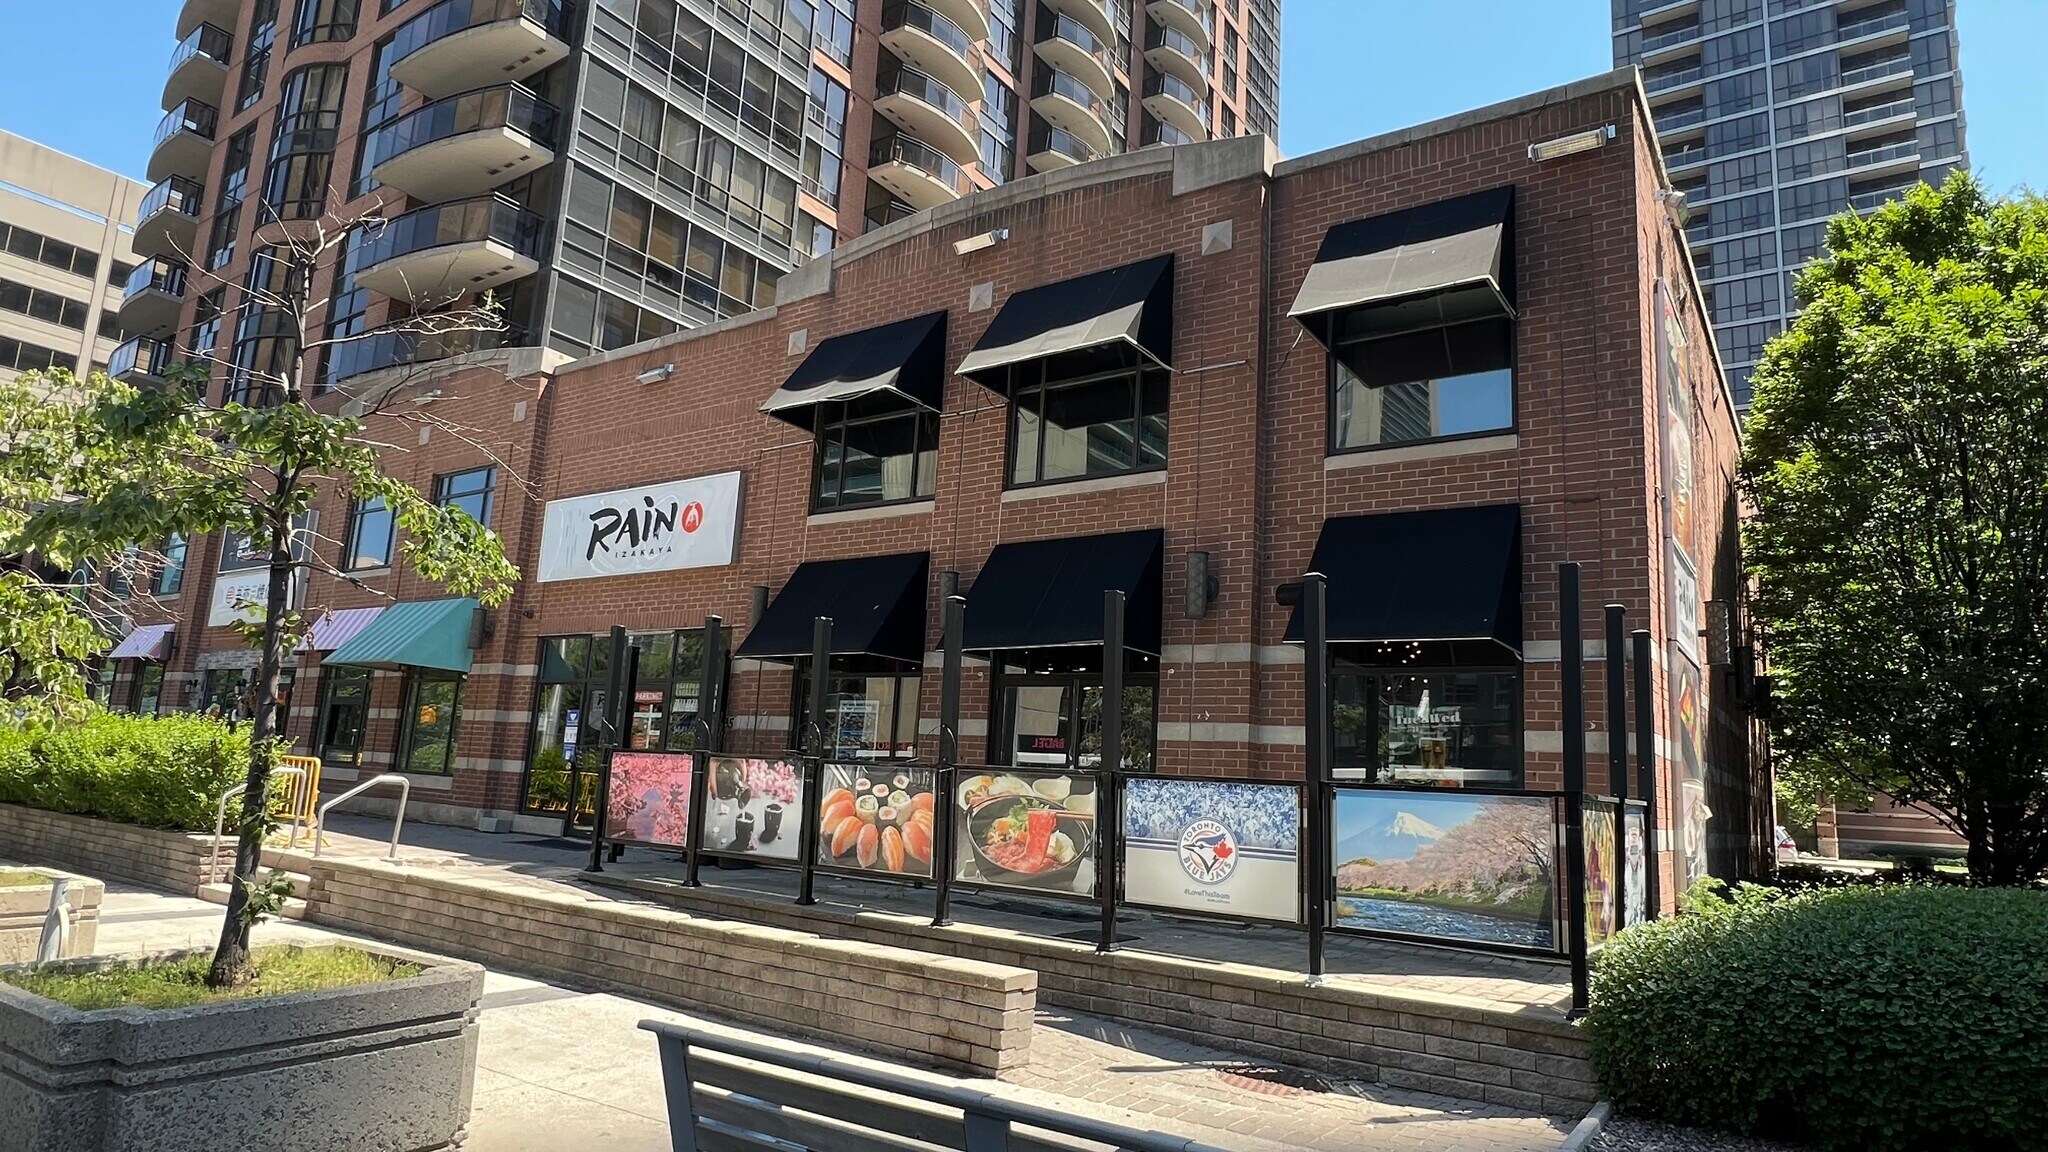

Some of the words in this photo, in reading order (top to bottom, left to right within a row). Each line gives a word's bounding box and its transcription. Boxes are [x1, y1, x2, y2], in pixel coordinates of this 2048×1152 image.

[615, 546, 673, 559] IZAKAYA
[1184, 822, 1222, 842] TORONTO
[1183, 855, 1205, 879] BLUE
[1209, 861, 1232, 881] JAYS
[1184, 888, 1230, 900] #LoveThisTeam
